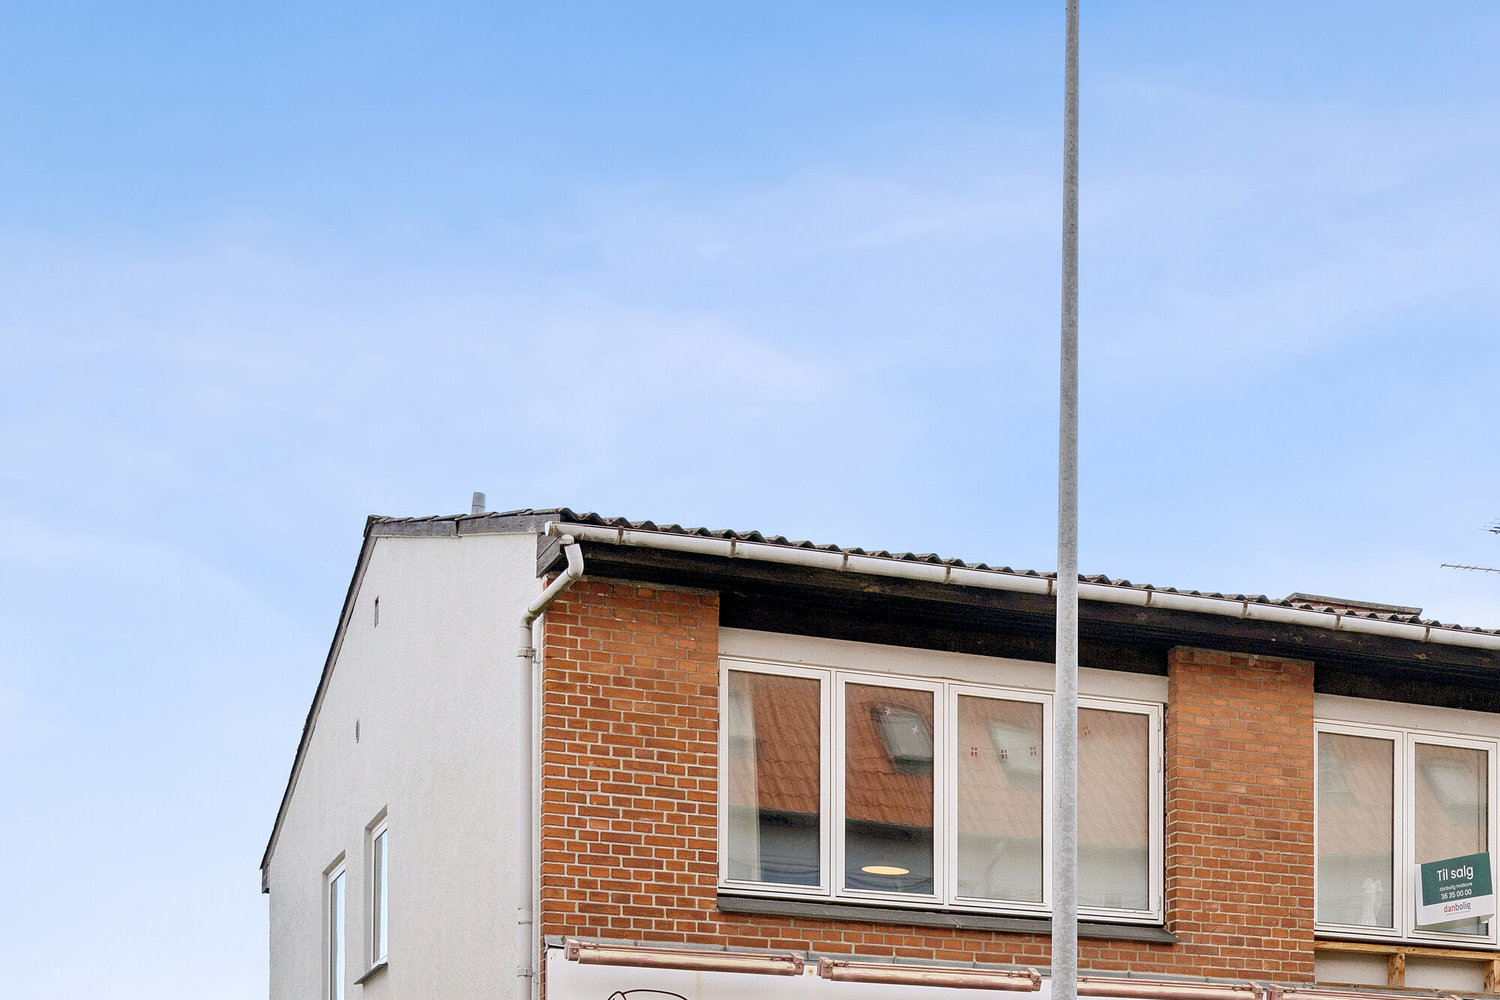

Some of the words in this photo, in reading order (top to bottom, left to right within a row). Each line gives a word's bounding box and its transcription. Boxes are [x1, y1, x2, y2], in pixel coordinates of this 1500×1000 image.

[1437, 869, 1448, 881] Til
[1451, 865, 1474, 879] salg
[1444, 902, 1471, 912] danbolig
